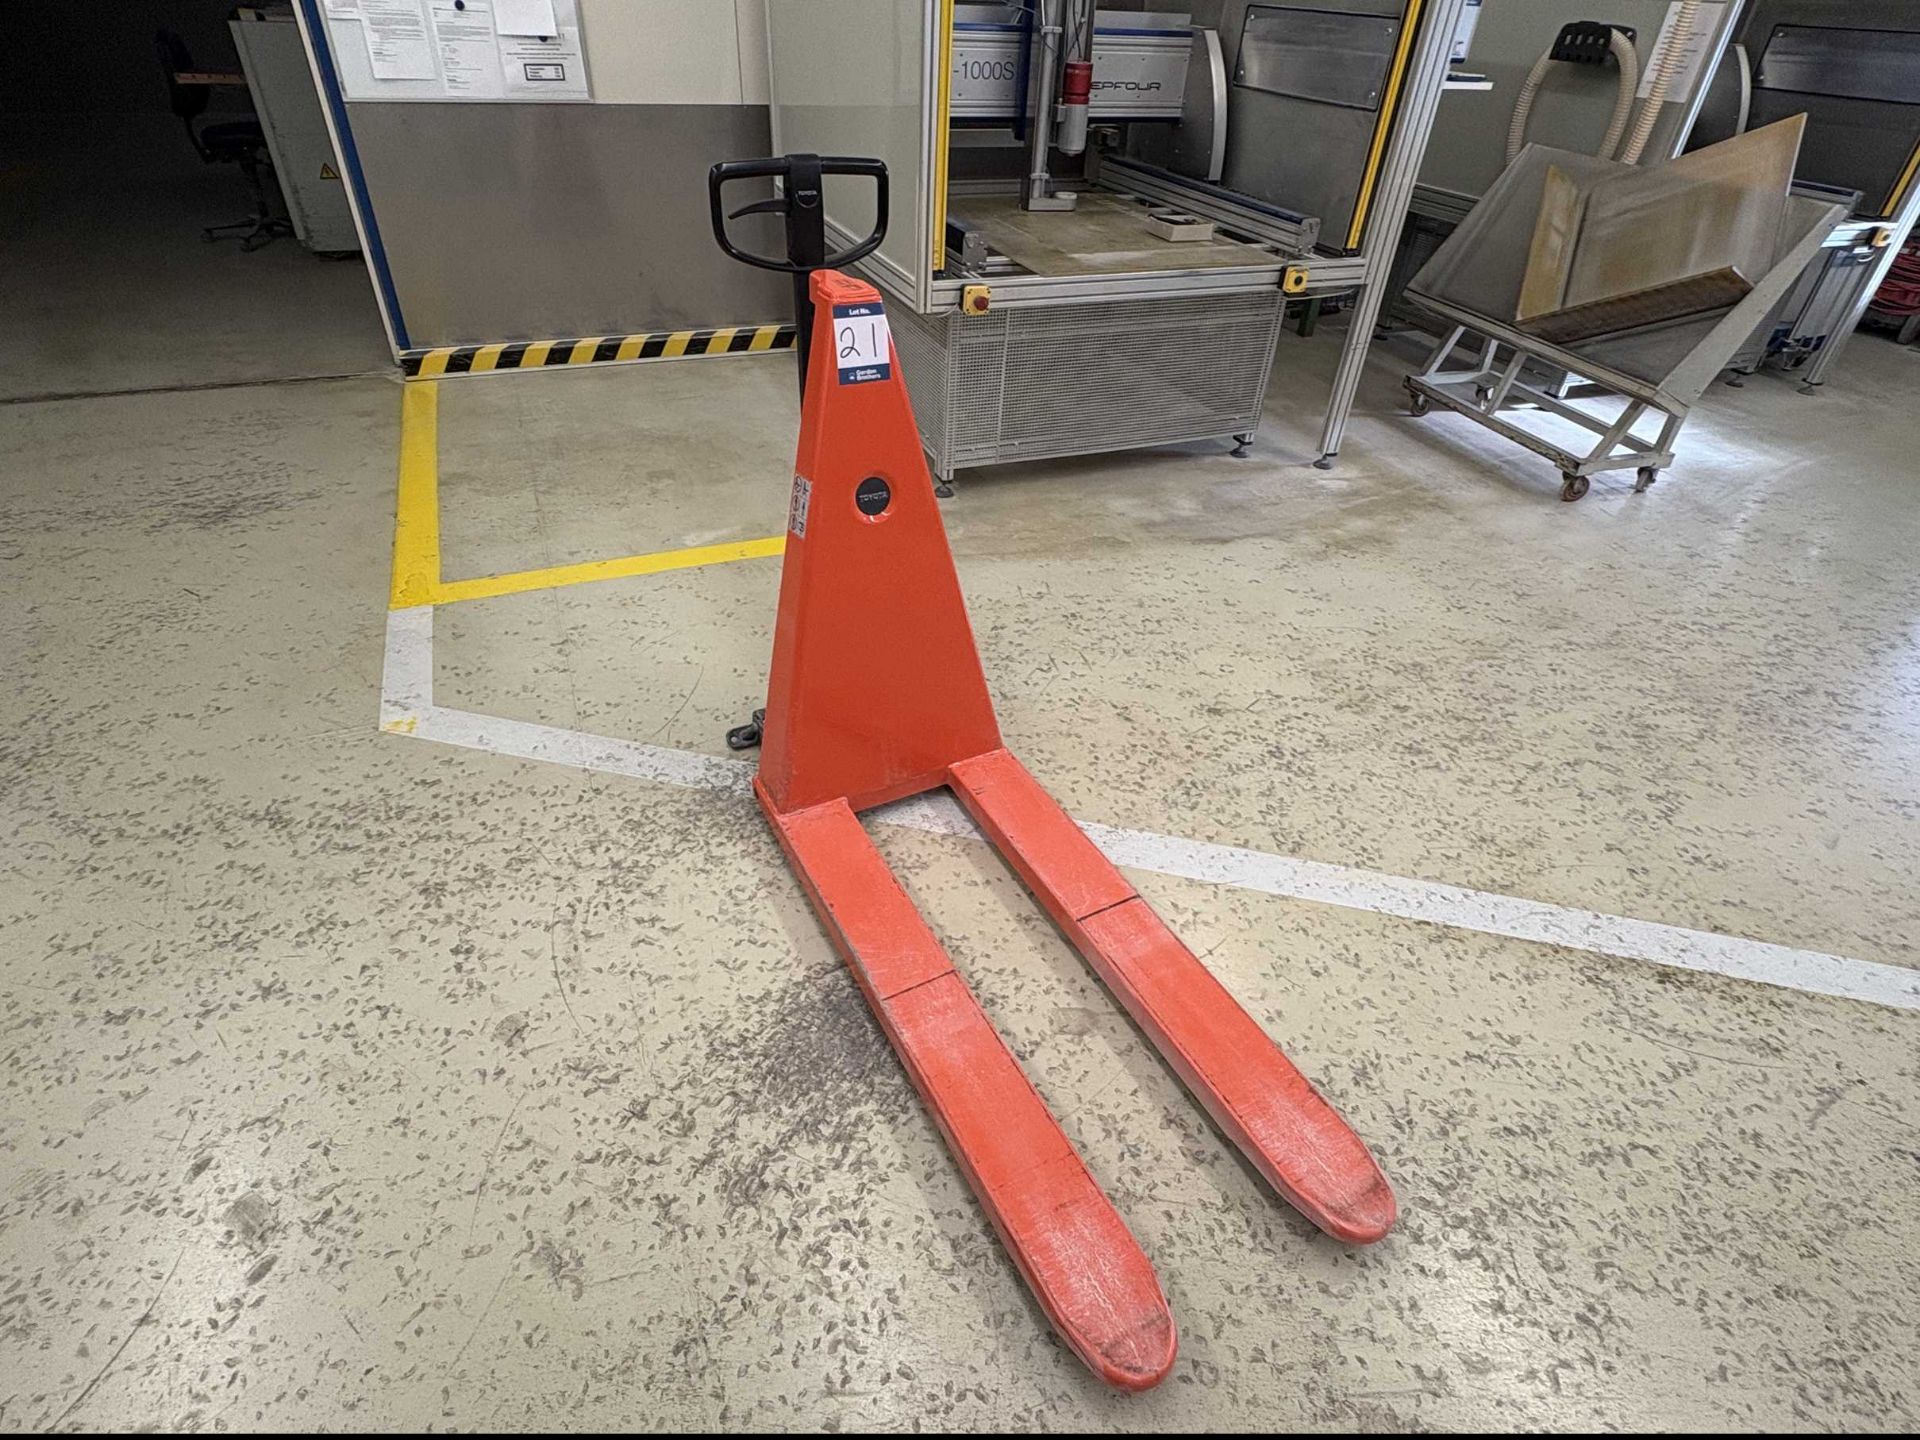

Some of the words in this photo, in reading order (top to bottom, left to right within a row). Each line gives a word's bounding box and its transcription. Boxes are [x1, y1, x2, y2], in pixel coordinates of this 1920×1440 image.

[953, 61, 1015, 80] -1000S
[849, 308, 859, 316] Lot
[840, 323, 877, 359] 21
